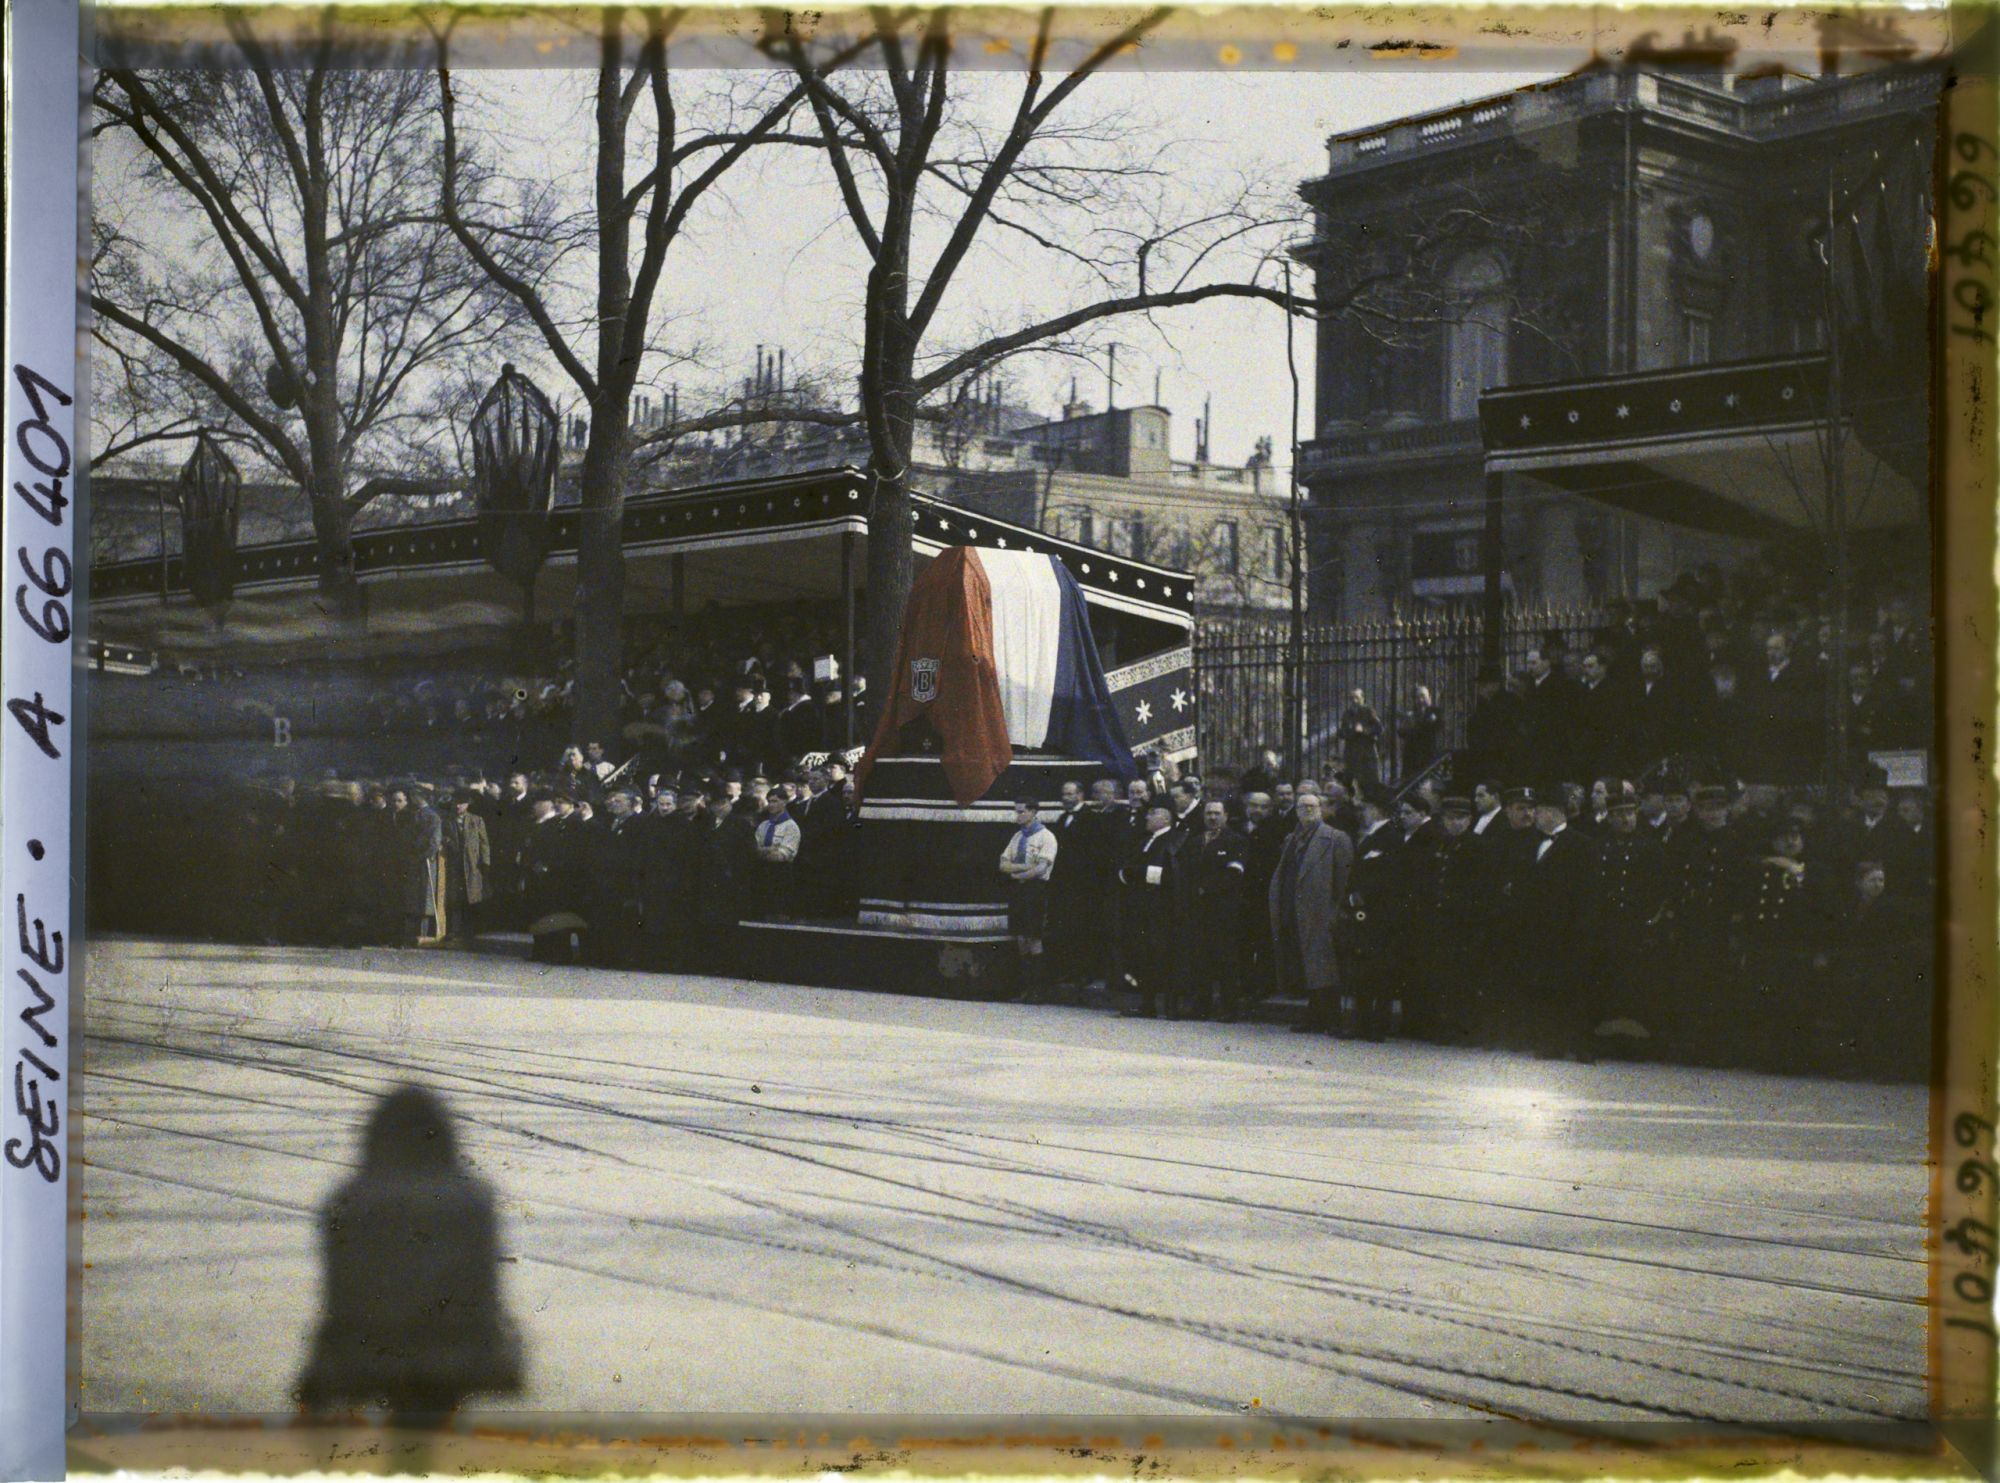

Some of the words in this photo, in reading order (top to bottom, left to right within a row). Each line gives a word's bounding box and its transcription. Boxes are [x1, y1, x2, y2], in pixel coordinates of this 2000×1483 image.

[8, 692, 65, 760] A
[273, 717, 292, 748] B
[5, 893, 64, 1183] SEINE
[1944, 1111, 1999, 1345] 66401
